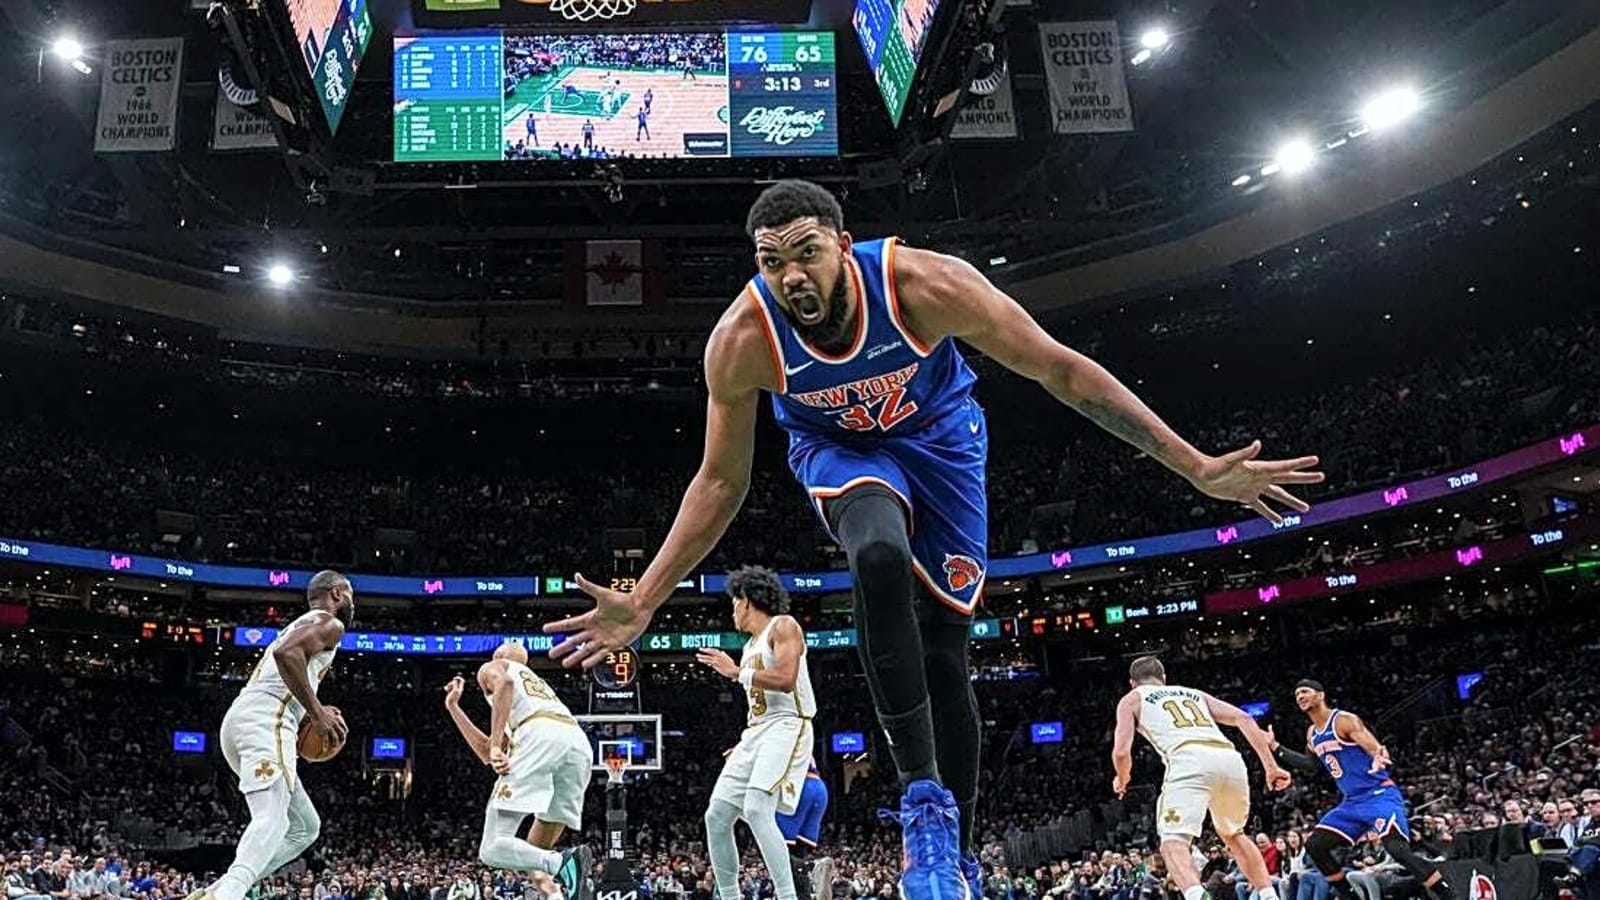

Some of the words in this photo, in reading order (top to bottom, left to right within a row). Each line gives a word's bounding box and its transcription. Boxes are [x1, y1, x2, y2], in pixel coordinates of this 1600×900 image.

[1048, 31, 1114, 47] BOSTON
[111, 49, 177, 67] BOSTON
[741, 46, 768, 63] 76
[795, 46, 821, 62] 65
[1052, 50, 1113, 66] CELTICS
[112, 67, 173, 84] CELTICS
[814, 77, 830, 88] 3rd
[764, 77, 801, 91] 3:13
[1068, 95, 1110, 106] WORLD
[117, 112, 159, 124] WORLD
[739, 106, 826, 127] Different
[1058, 108, 1126, 121] CHAMPIONS
[101, 126, 171, 139] CHAMPIONS
[748, 121, 817, 145] Here
[847, 361, 920, 401] YORK
[835, 387, 918, 431] 32
[1560, 433, 1586, 454] lyft
[1448, 476, 1461, 488] To
[1461, 472, 1478, 484] the
[1383, 487, 1408, 506] lyft
[1284, 515, 1301, 527] the
[1216, 526, 1238, 544] lyft
[1530, 534, 1544, 545] To
[1544, 530, 1563, 542] the
[0, 543, 11, 553] To
[12, 545, 29, 556] the
[1106, 547, 1118, 558] To
[1118, 546, 1135, 556] the
[1457, 546, 1483, 566] lyft
[110, 555, 131, 570] lyft
[1052, 551, 1072, 568] lyft
[166, 563, 177, 573] To
[177, 565, 193, 576] the
[269, 571, 289, 586] lyft
[476, 581, 487, 590] To
[488, 581, 503, 591] the
[794, 578, 806, 587] To
[806, 577, 822, 587] the
[1325, 576, 1339, 587] To
[1339, 574, 1357, 586] the
[424, 580, 443, 594] lyft
[1259, 585, 1280, 602] lyft
[1126, 607, 1149, 617] Bank
[1156, 602, 1179, 615] 2:23
[1180, 600, 1198, 612] PM
[527, 634, 553, 649] YORK
[650, 635, 671, 648] 65
[681, 634, 721, 649] BOSTON
[615, 664, 628, 685] 9
[751, 686, 768, 716] 3
[1162, 699, 1214, 729] 11
[1325, 754, 1343, 779] 3
